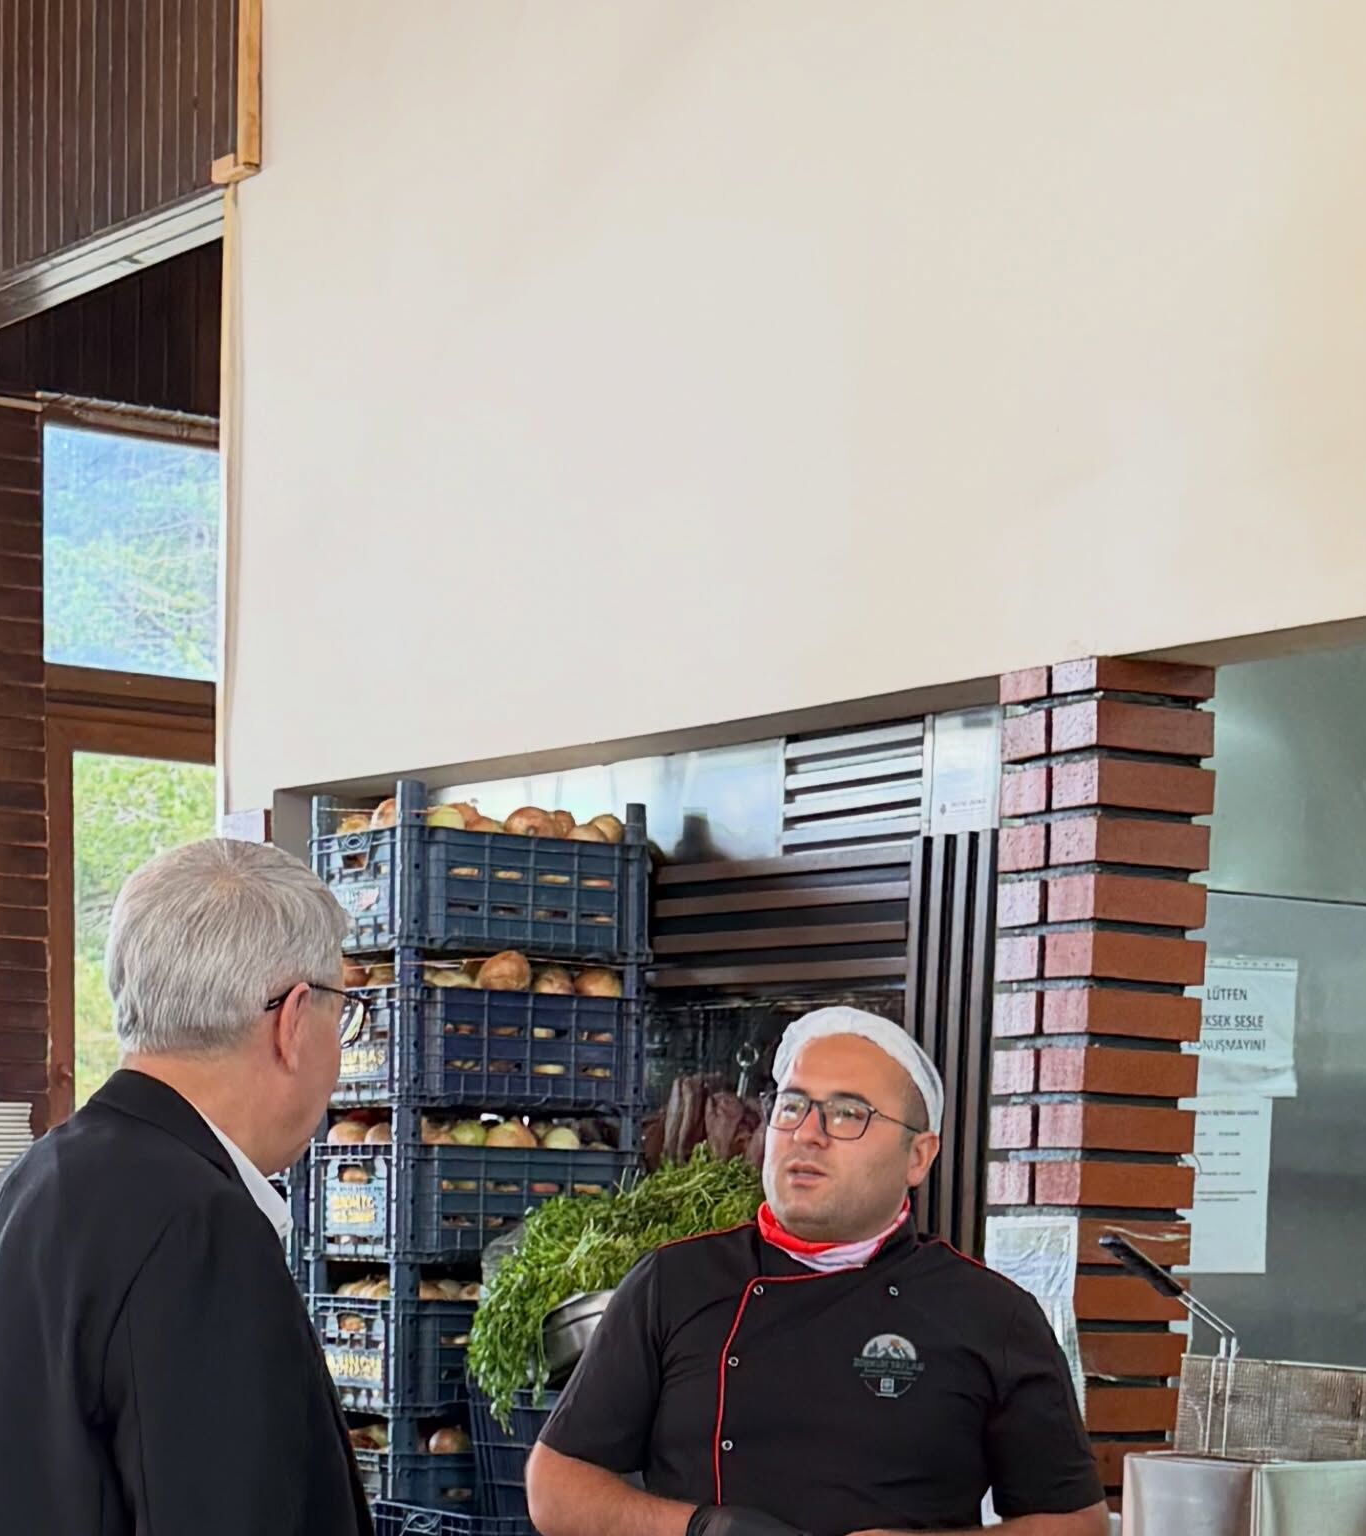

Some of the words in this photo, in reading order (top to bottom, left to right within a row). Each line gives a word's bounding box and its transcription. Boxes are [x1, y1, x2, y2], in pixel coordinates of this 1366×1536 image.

[1207, 985, 1248, 1001] LÜTFEN
[1204, 1014, 1232, 1027] KSEK
[1235, 1015, 1264, 1028] SESLE
